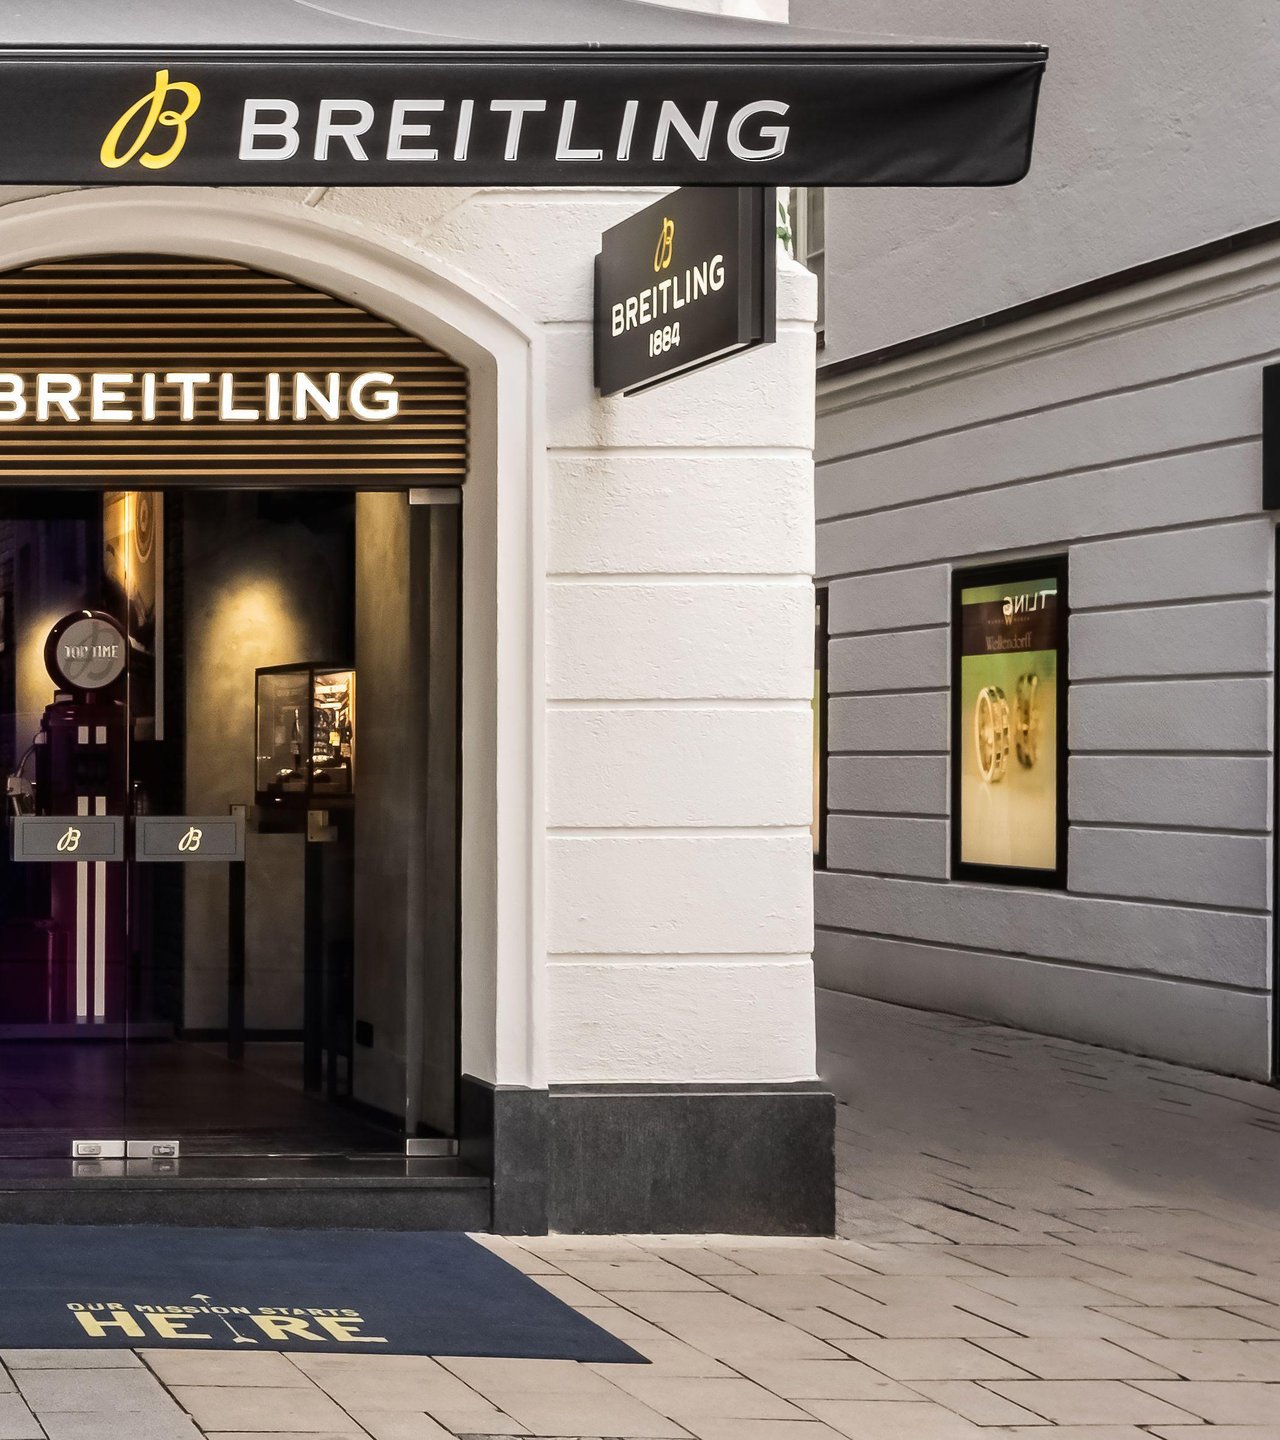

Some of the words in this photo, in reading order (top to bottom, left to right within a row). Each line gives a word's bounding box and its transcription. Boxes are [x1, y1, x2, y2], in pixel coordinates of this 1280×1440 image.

[239, 98, 790, 161] BREITLING
[611, 254, 725, 337] BREITLING
[649, 322, 680, 357] 1884
[64, 645, 89, 659] TOP
[91, 645, 119, 658] TIME
[66, 1302, 125, 1311] OUR
[134, 1304, 249, 1315] MISSION
[257, 1306, 360, 1317] STARTS
